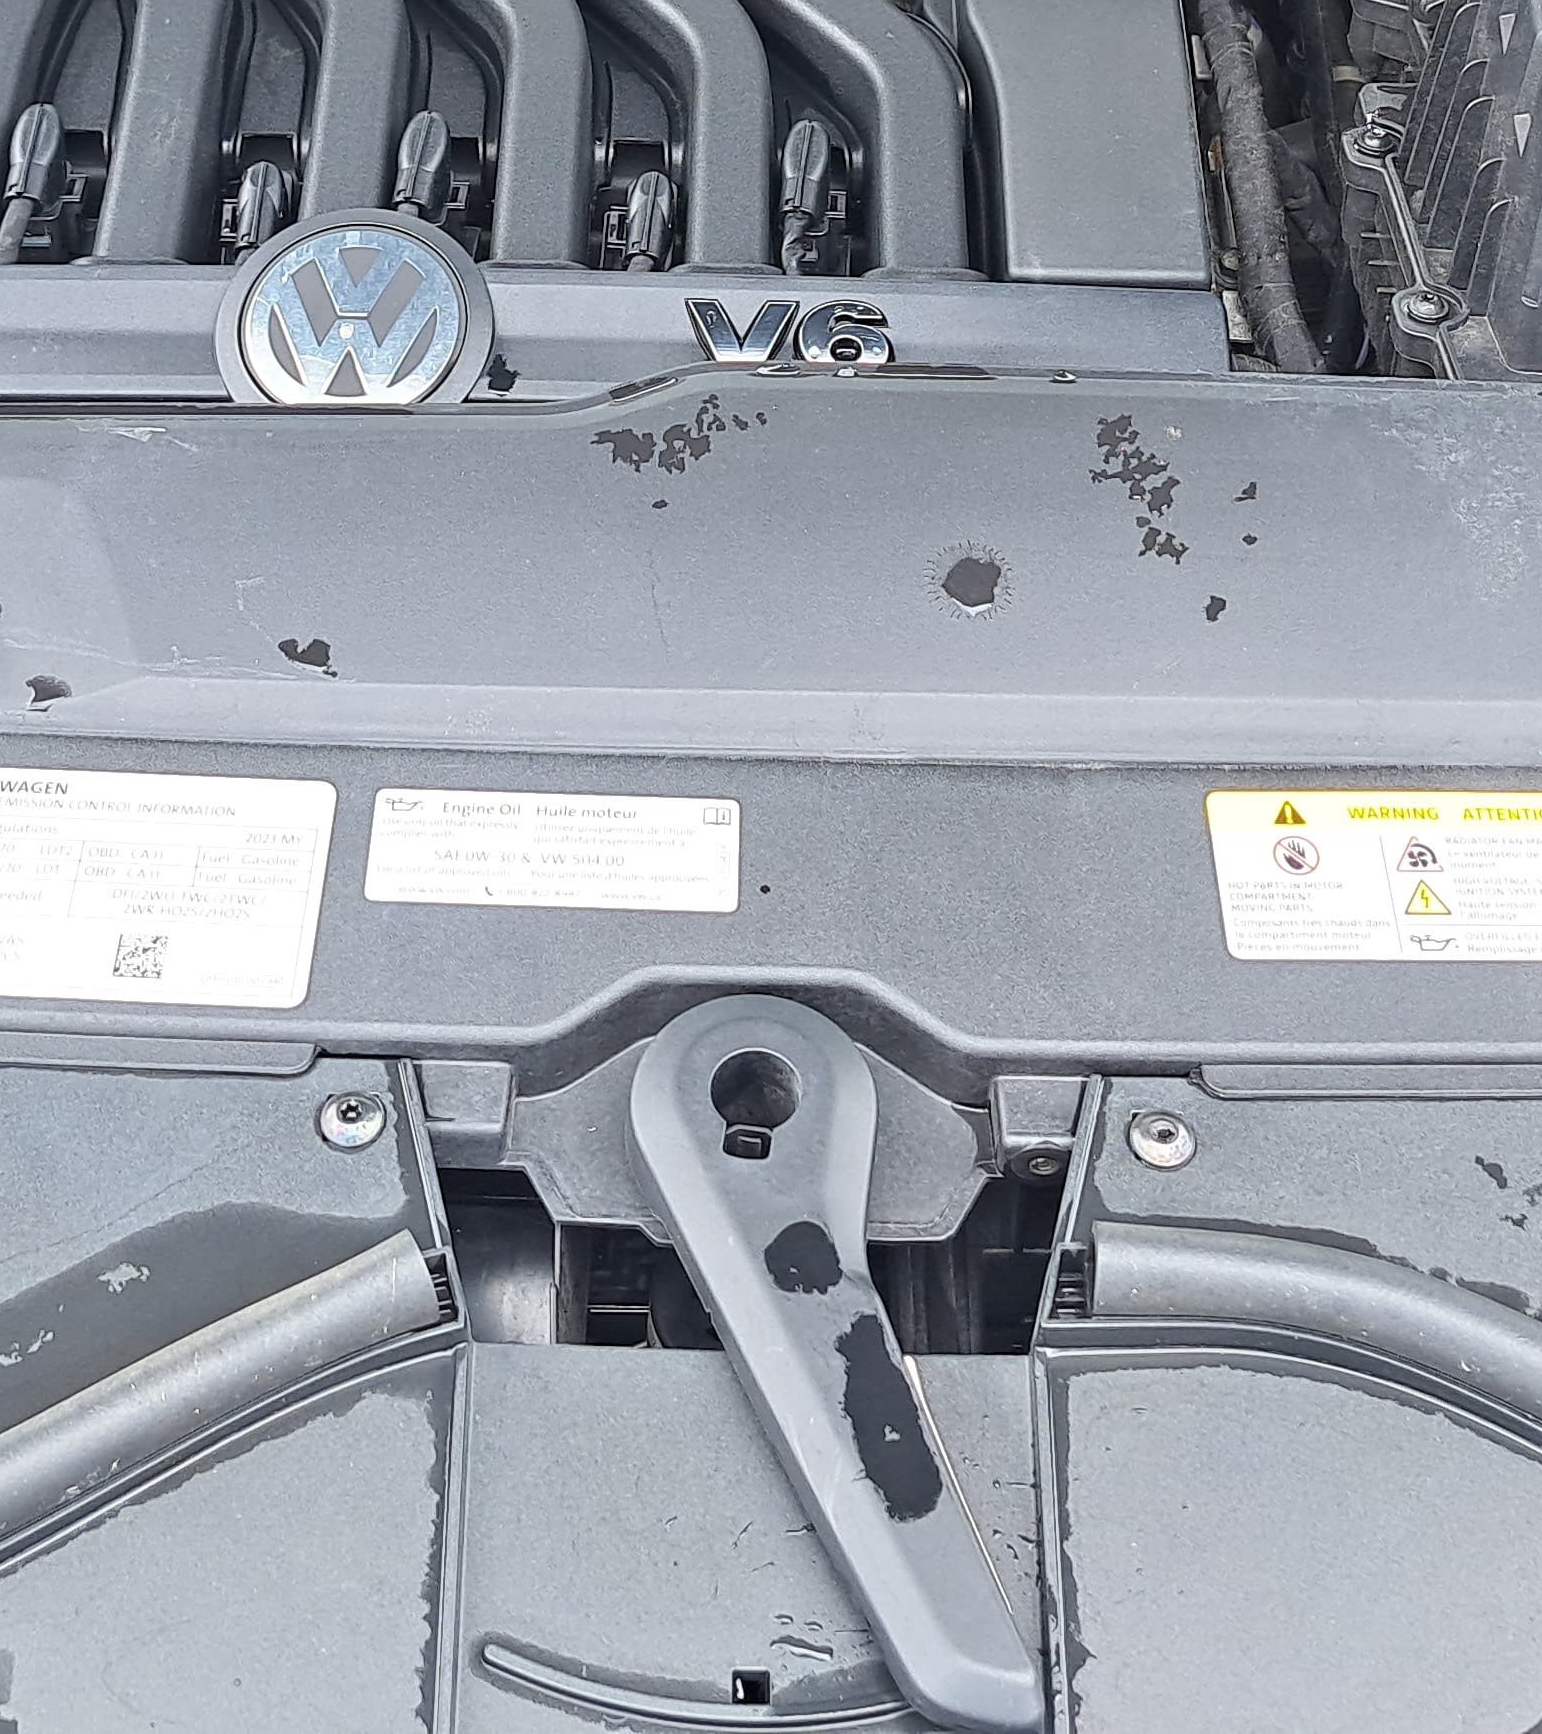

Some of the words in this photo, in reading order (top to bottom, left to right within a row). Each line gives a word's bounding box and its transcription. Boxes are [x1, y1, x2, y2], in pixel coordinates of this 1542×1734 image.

[684, 296, 894, 365] V6
[68, 799, 131, 812] CONTROL
[137, 802, 236, 817] INFORMATION
[442, 802, 495, 817] Engine
[499, 803, 521, 815] Oil
[536, 804, 577, 818] Huile
[581, 808, 638, 819] moteur
[1347, 806, 1439, 820] WARNING
[445, 819, 466, 827] that
[469, 821, 518, 832] expressly
[647, 827, 660, 835] de
[281, 833, 304, 845] MY
[1444, 837, 1499, 845] RADIATOR
[521, 852, 531, 863] &
[540, 852, 567, 865] VW
[572, 854, 600, 866] 504
[605, 855, 625, 866] 00
[1463, 850, 1521, 858] ventilateur
[241, 854, 300, 866] Gasoline
[1450, 860, 1497, 868] moment
[237, 874, 297, 886] Gasoline
[1228, 881, 1250, 889] HOT
[1253, 882, 1287, 890] PARTS
[1304, 882, 1344, 890] MOTOR
[1228, 892, 1313, 901] COMPARTMENT
[1231, 903, 1276, 912] MOVING
[1279, 904, 1313, 913] PARTS
[1458, 901, 1491, 909] Haute
[1233, 919, 1299, 928] Composants
[1325, 919, 1362, 927] chauds
[1365, 920, 1391, 928] dans
[1248, 931, 1327, 940] compartiment
[1465, 932, 1532, 941] OVERFILLED
[1276, 944, 1289, 952] en
[1292, 944, 1360, 952] mouvement
[1467, 944, 1537, 954] Remplissage
